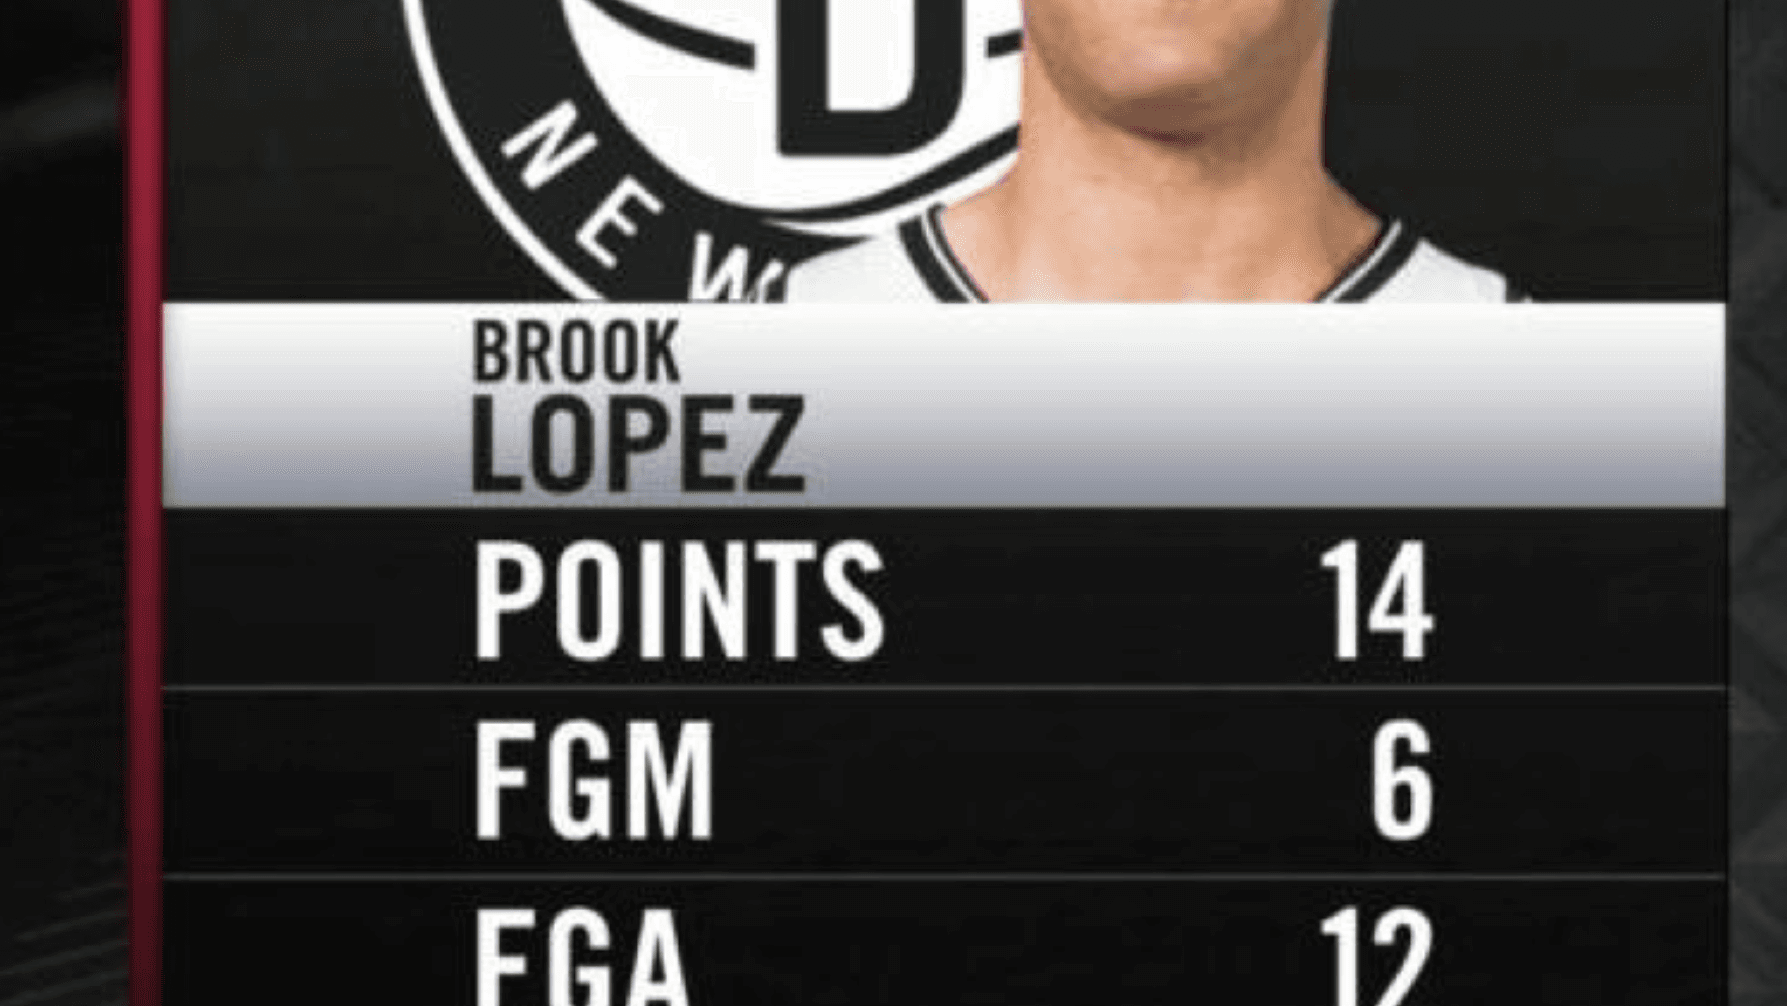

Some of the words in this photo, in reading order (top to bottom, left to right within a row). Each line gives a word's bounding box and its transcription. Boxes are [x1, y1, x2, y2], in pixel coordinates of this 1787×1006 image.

[474, 318, 680, 384] BROOK
[471, 393, 806, 495] LOPEZ
[476, 538, 885, 663] POINTS
[1319, 538, 1435, 661] 14
[476, 718, 712, 842] FGM
[1372, 718, 1434, 842] 6
[476, 906, 690, 1006] FGA
[1319, 906, 1434, 1006] 12
